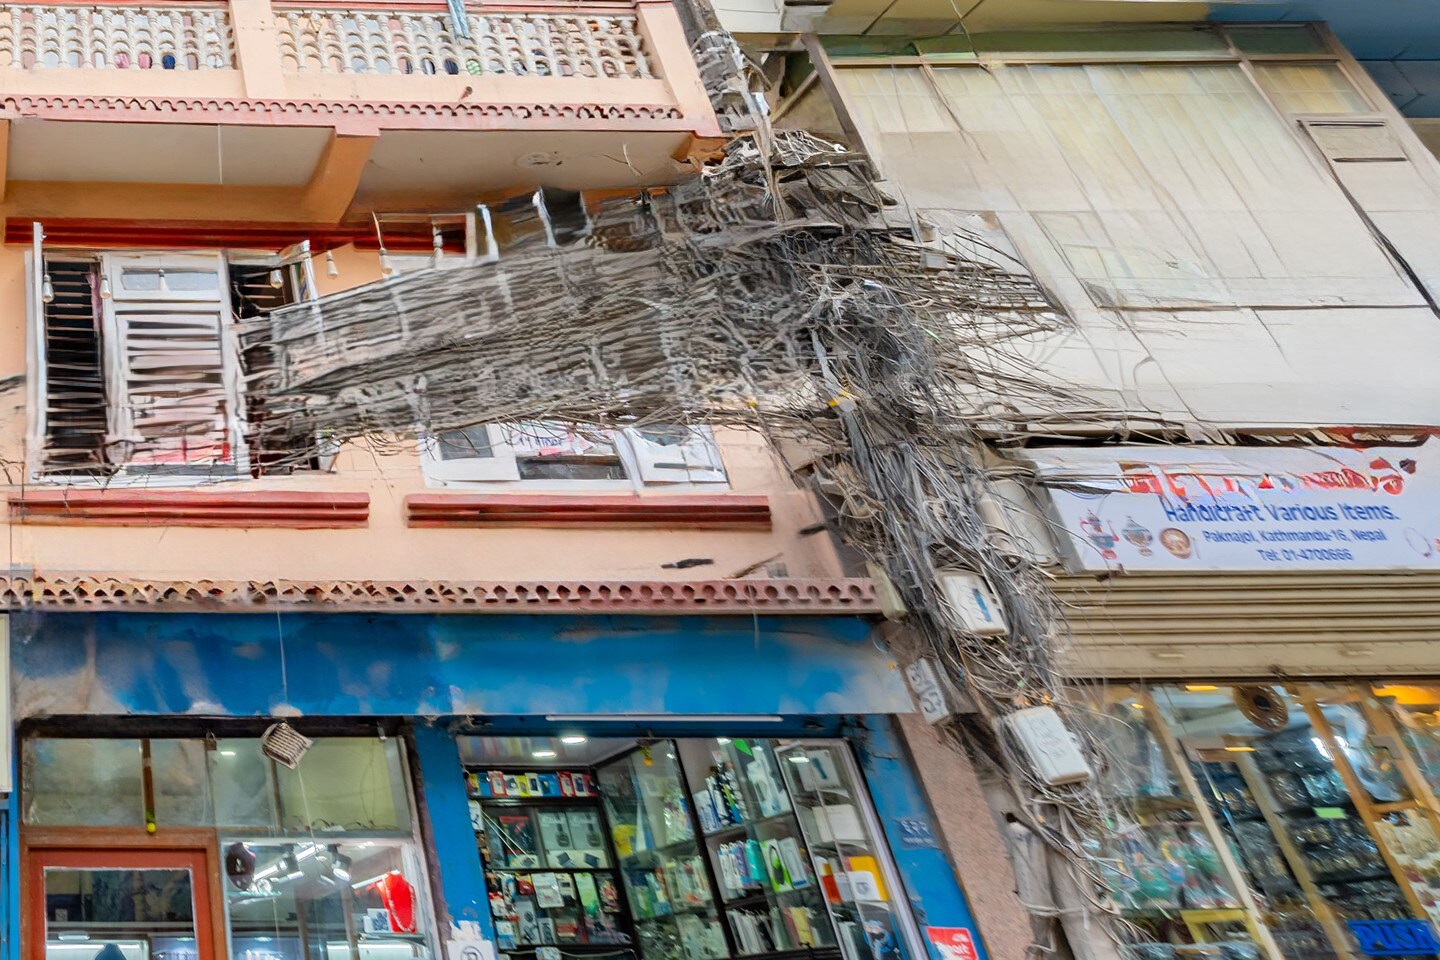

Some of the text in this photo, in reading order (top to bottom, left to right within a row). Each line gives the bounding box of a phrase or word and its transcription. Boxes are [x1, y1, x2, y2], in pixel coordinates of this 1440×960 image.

[1163, 502, 1401, 523] Handicraft Various Items.
[1349, 528, 1388, 542] Nepal
[1256, 548, 1354, 561] Tel: 01-4700666
[1351, 922, 1434, 951] PUSH
